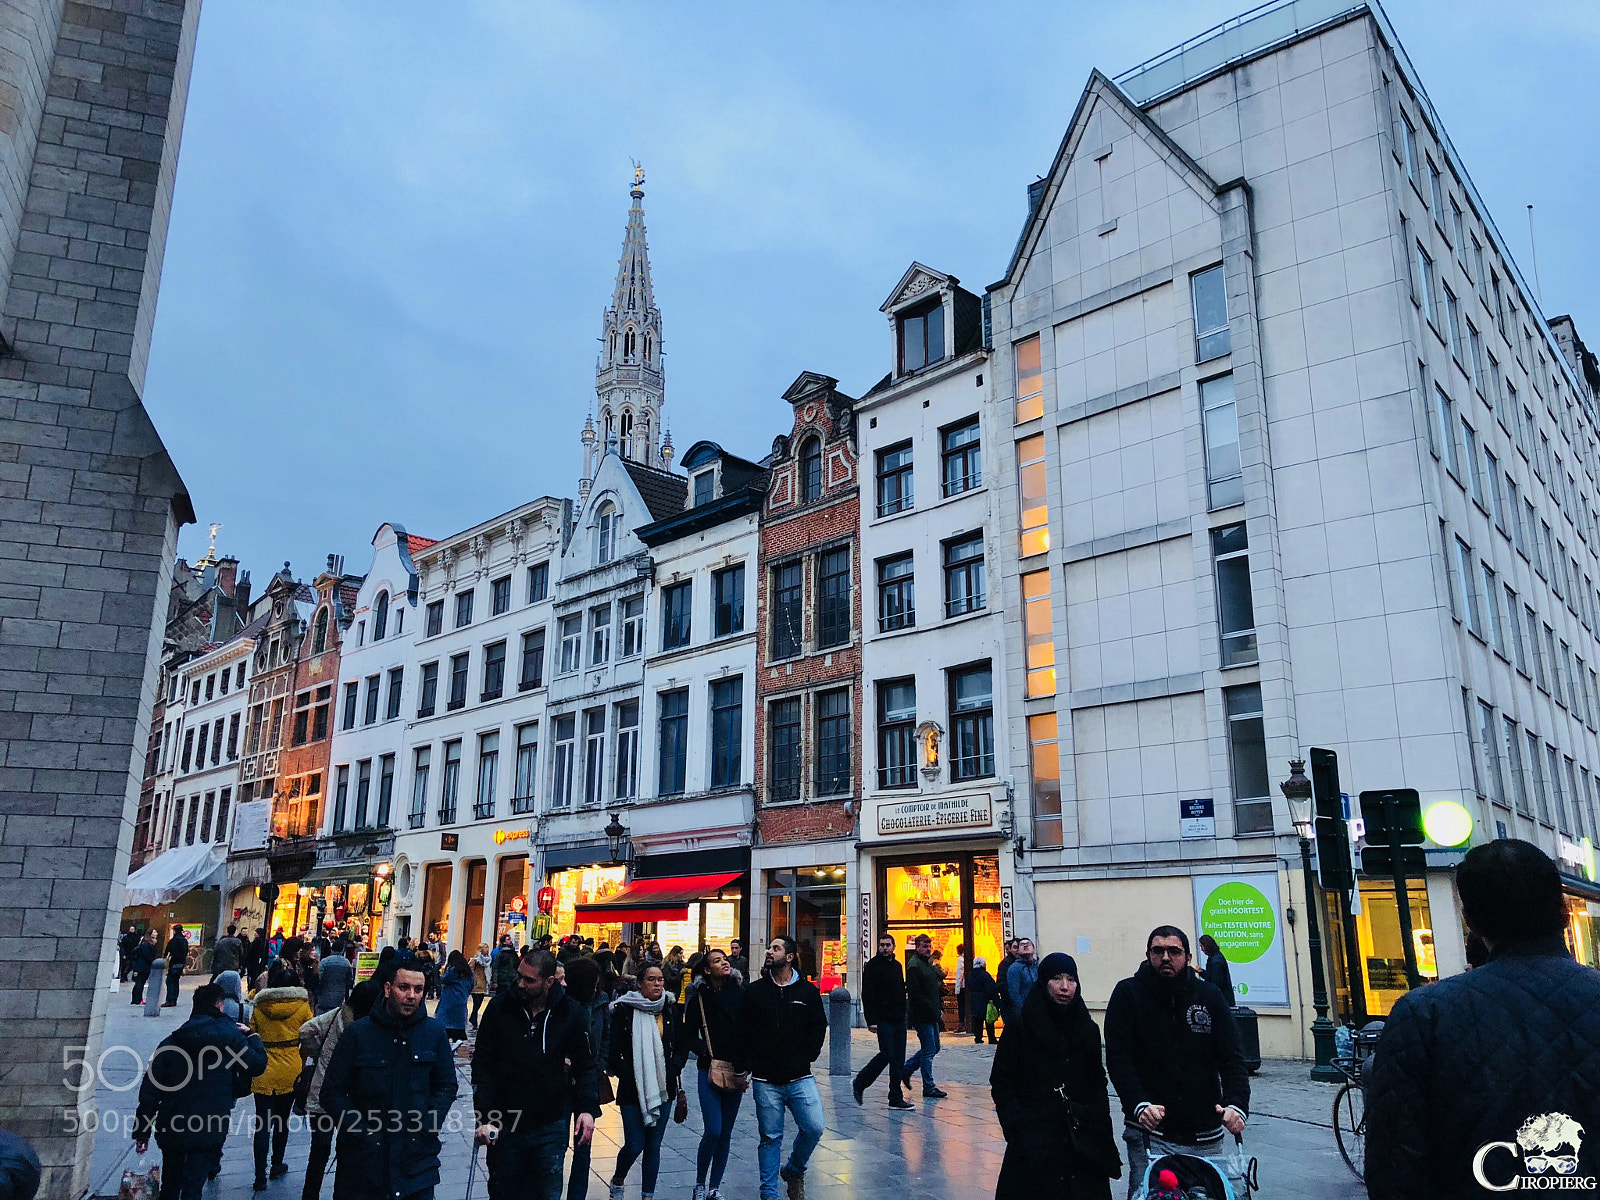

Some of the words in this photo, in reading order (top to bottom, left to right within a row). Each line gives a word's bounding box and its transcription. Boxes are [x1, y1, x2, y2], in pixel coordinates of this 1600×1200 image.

[901, 803, 930, 814] COMPTOIR
[938, 799, 969, 810] MATHILDE
[970, 808, 988, 822] FINE
[506, 829, 530, 841] express
[1209, 907, 1227, 916] gratis
[1228, 907, 1264, 915] HOORTEST
[1223, 921, 1248, 929] TESTER
[1248, 921, 1272, 929] VOTRE
[1214, 930, 1249, 938] AUDITION,
[1219, 940, 1260, 949] engagement
